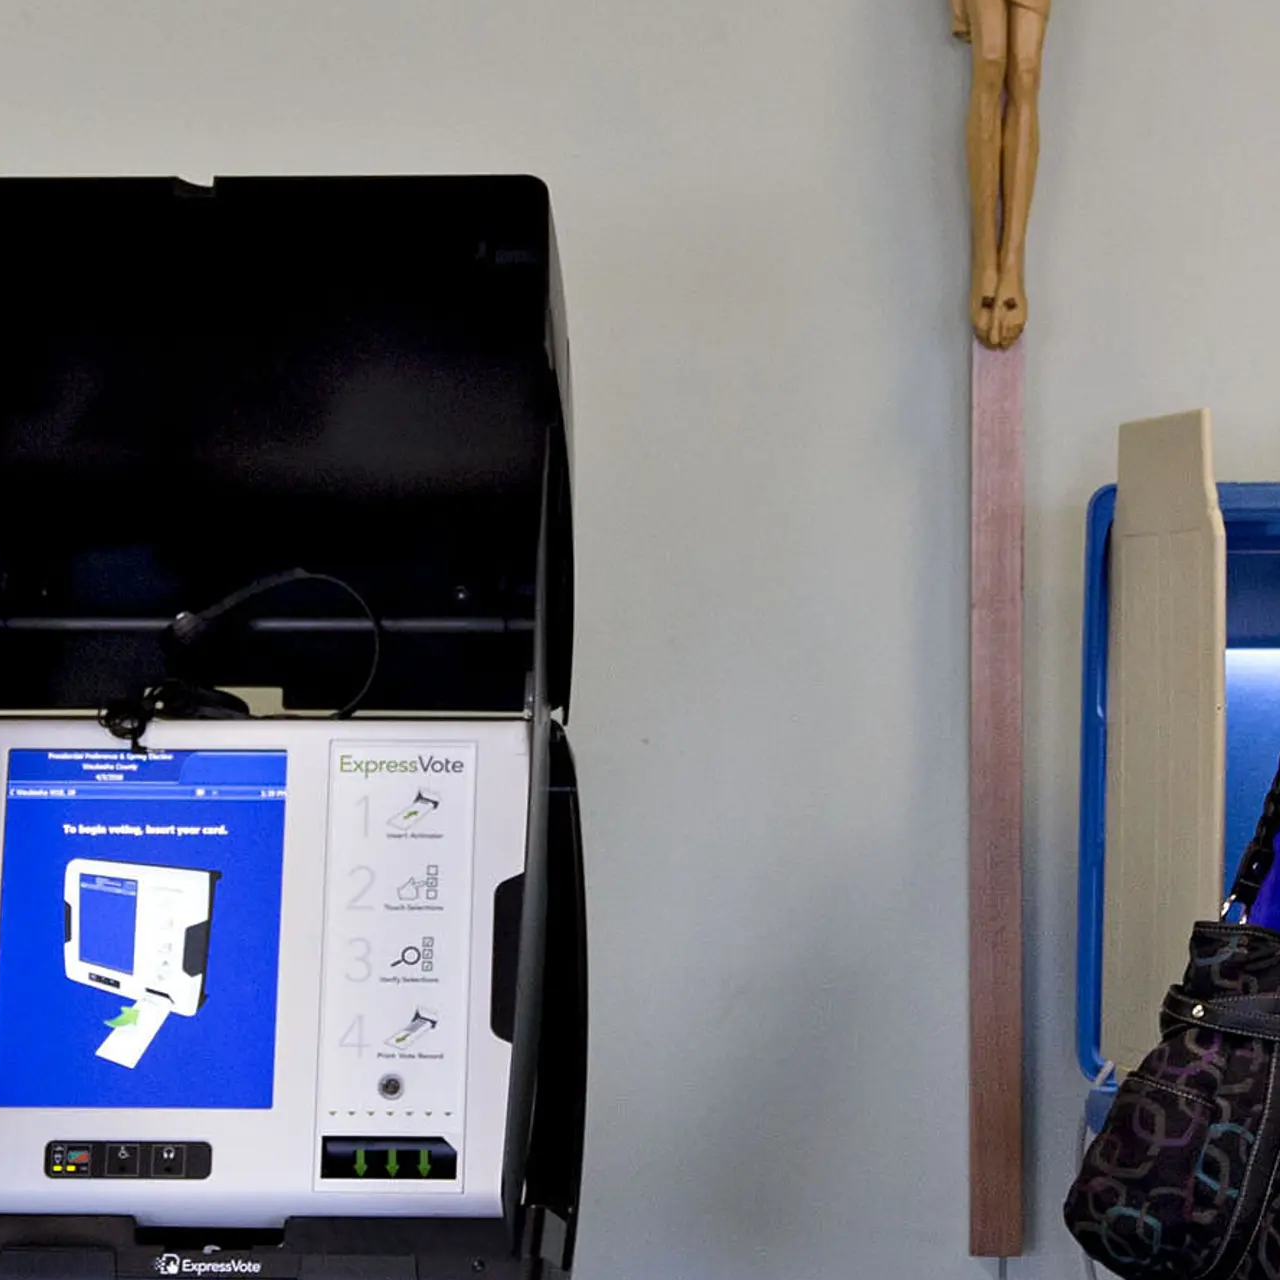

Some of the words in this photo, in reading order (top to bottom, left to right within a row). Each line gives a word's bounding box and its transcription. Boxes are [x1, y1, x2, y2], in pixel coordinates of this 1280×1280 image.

[339, 754, 465, 780] ExpressVote
[63, 823, 77, 835] To
[78, 823, 107, 837] begin
[108, 823, 144, 837] voting,
[145, 823, 175, 835] insert
[176, 825, 200, 837] your
[202, 823, 229, 836] card.
[354, 794, 370, 839] 1
[344, 864, 376, 911] 2
[343, 936, 373, 983] 3
[338, 1013, 372, 1060] 4
[181, 1259, 261, 1276] ExpressVote
